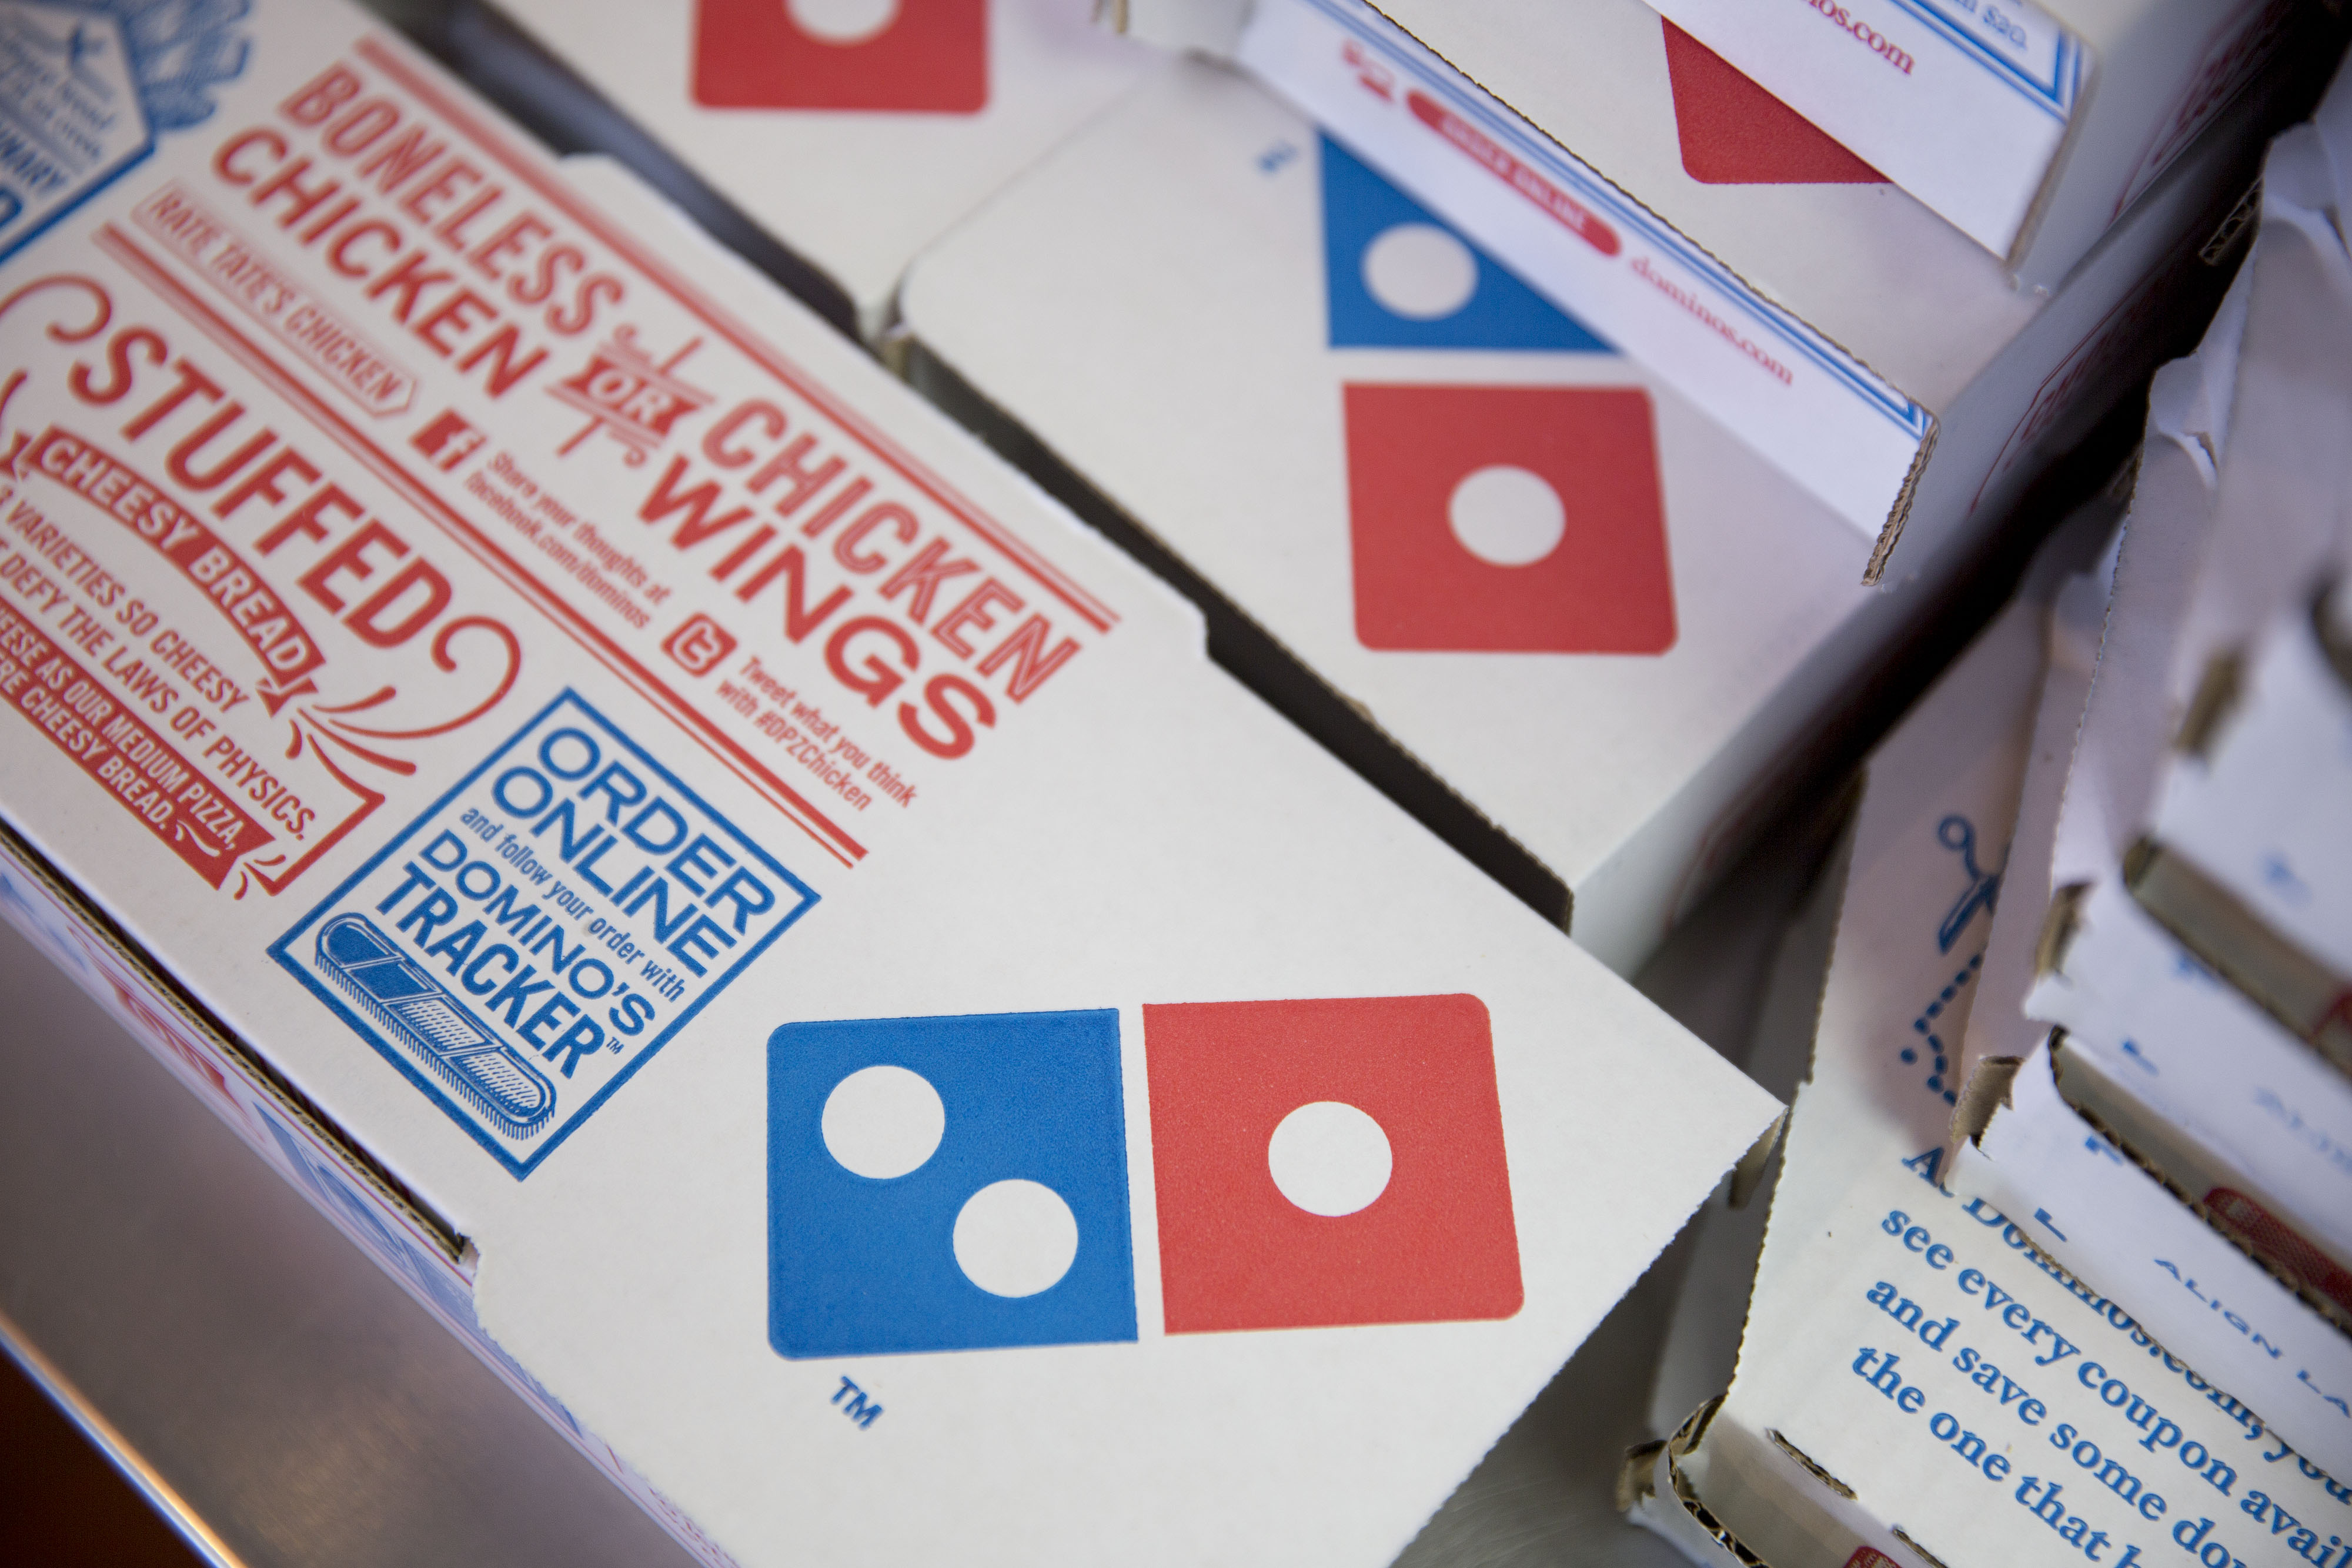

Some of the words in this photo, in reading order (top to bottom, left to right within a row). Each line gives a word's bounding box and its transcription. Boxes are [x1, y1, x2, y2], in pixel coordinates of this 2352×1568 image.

[149, 189, 226, 256] RATE
[282, 305, 403, 403] CHICKEN
[212, 126, 550, 399] CHICKEN
[276, 60, 625, 337] BONELESS
[589, 362, 674, 428] OR
[1629, 256, 1795, 388] dominos.com
[41, 437, 201, 551] CHEESY
[188, 545, 308, 672] BREAD
[67, 323, 453, 649] STUFFED
[464, 471, 651, 630] facebook.com/dominos
[488, 451, 537, 499] Share
[534, 492, 579, 528] your
[573, 524, 650, 588] thoughts
[643, 584, 673, 606] at
[702, 398, 1083, 704] CHICKEN
[0, 551, 70, 614] DEFY
[58, 603, 115, 658] THE
[101, 646, 179, 713] LAWS
[170, 706, 216, 741] OF
[202, 735, 316, 841] PHYSICS.
[6, 500, 125, 608] VARIETIES
[115, 599, 159, 637] SO
[149, 628, 250, 713] CHEESY
[638, 453, 998, 760] WINGS
[0, 604, 48, 667] EESE
[35, 657, 74, 688] AS
[63, 680, 113, 727] OUR
[102, 714, 189, 794] MEDIUM
[177, 782, 246, 850] PIZZA,
[20, 686, 108, 763] CHEESY
[97, 755, 176, 830] BREAD.
[538, 727, 777, 937] ORDER
[715, 680, 760, 718] with
[754, 711, 874, 812] #DPZChicken
[739, 656, 798, 707] Tweet
[790, 702, 840, 743] what
[828, 737, 871, 770] you
[866, 761, 918, 808] think
[419, 828, 656, 1037] DOMINO'S
[460, 807, 504, 841] and
[496, 833, 553, 887] follow
[542, 880, 594, 922] your
[588, 916, 646, 966] order
[645, 959, 687, 1004] with
[492, 766, 738, 979] ONLINE
[1881, 1209, 1955, 1270] see
[1957, 1268, 2082, 1367] every
[2076, 1360, 2238, 1497] coupon
[2153, 1258, 2284, 1360] ALIGN
[1851, 1346, 1927, 1415] the
[1929, 1412, 2012, 1483] one
[2014, 1475, 2112, 1562] that
[1866, 1279, 1960, 1352] and
[1952, 1348, 2048, 1426] save
[2049, 1423, 2167, 1522] some
[2171, 1517, 2248, 1568] do
